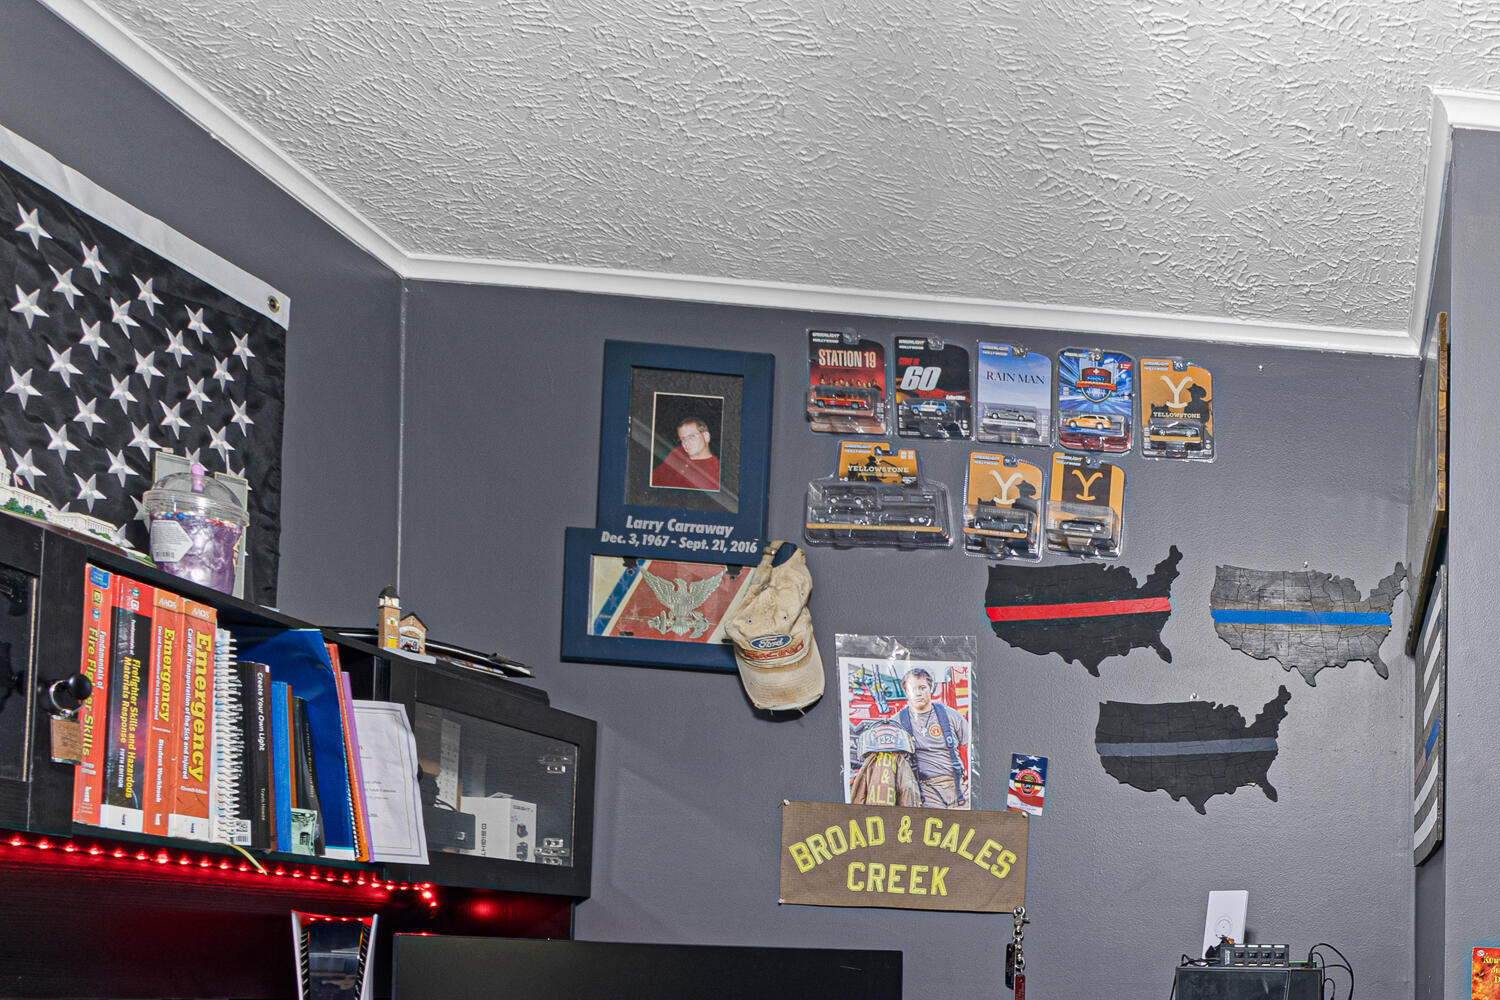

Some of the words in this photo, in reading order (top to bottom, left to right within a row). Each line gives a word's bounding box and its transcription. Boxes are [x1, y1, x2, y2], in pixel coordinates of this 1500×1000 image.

[818, 348, 862, 368] STATION
[864, 351, 876, 368] 19
[900, 366, 942, 392] 60
[986, 370, 1016, 384] RAIN
[1018, 374, 1045, 385] MAN
[1153, 411, 1201, 420] YELLOWSTONE
[848, 464, 910, 474] YELLOWSTONE
[626, 515, 664, 532] Larry
[667, 518, 734, 538] Carraway
[601, 531, 627, 544] Dec.
[629, 533, 640, 547] 3,
[642, 535, 670, 548] 1967
[678, 538, 710, 552] Sept.
[710, 540, 728, 554] 21,
[730, 541, 758, 554] 2016
[87, 627, 97, 656] Fire
[758, 638, 784, 650] Ford
[98, 630, 106, 680] Fundamentals
[97, 680, 104, 690] of
[122, 656, 132, 699] Materials
[129, 658, 141, 705] Firefighter
[158, 628, 176, 722] Emergency
[184, 658, 192, 706] Transportation
[128, 706, 138, 732] Skills
[184, 707, 191, 715] of
[188, 631, 212, 782] Emergency
[120, 700, 130, 743] Response
[82, 714, 94, 756] Skills
[128, 733, 136, 750] and
[126, 751, 136, 798] Hazardous
[881, 768, 890, 784] &
[788, 816, 886, 874] BROAD
[897, 815, 913, 844] &
[922, 817, 1017, 879] GALES
[846, 862, 950, 896] CREEK
